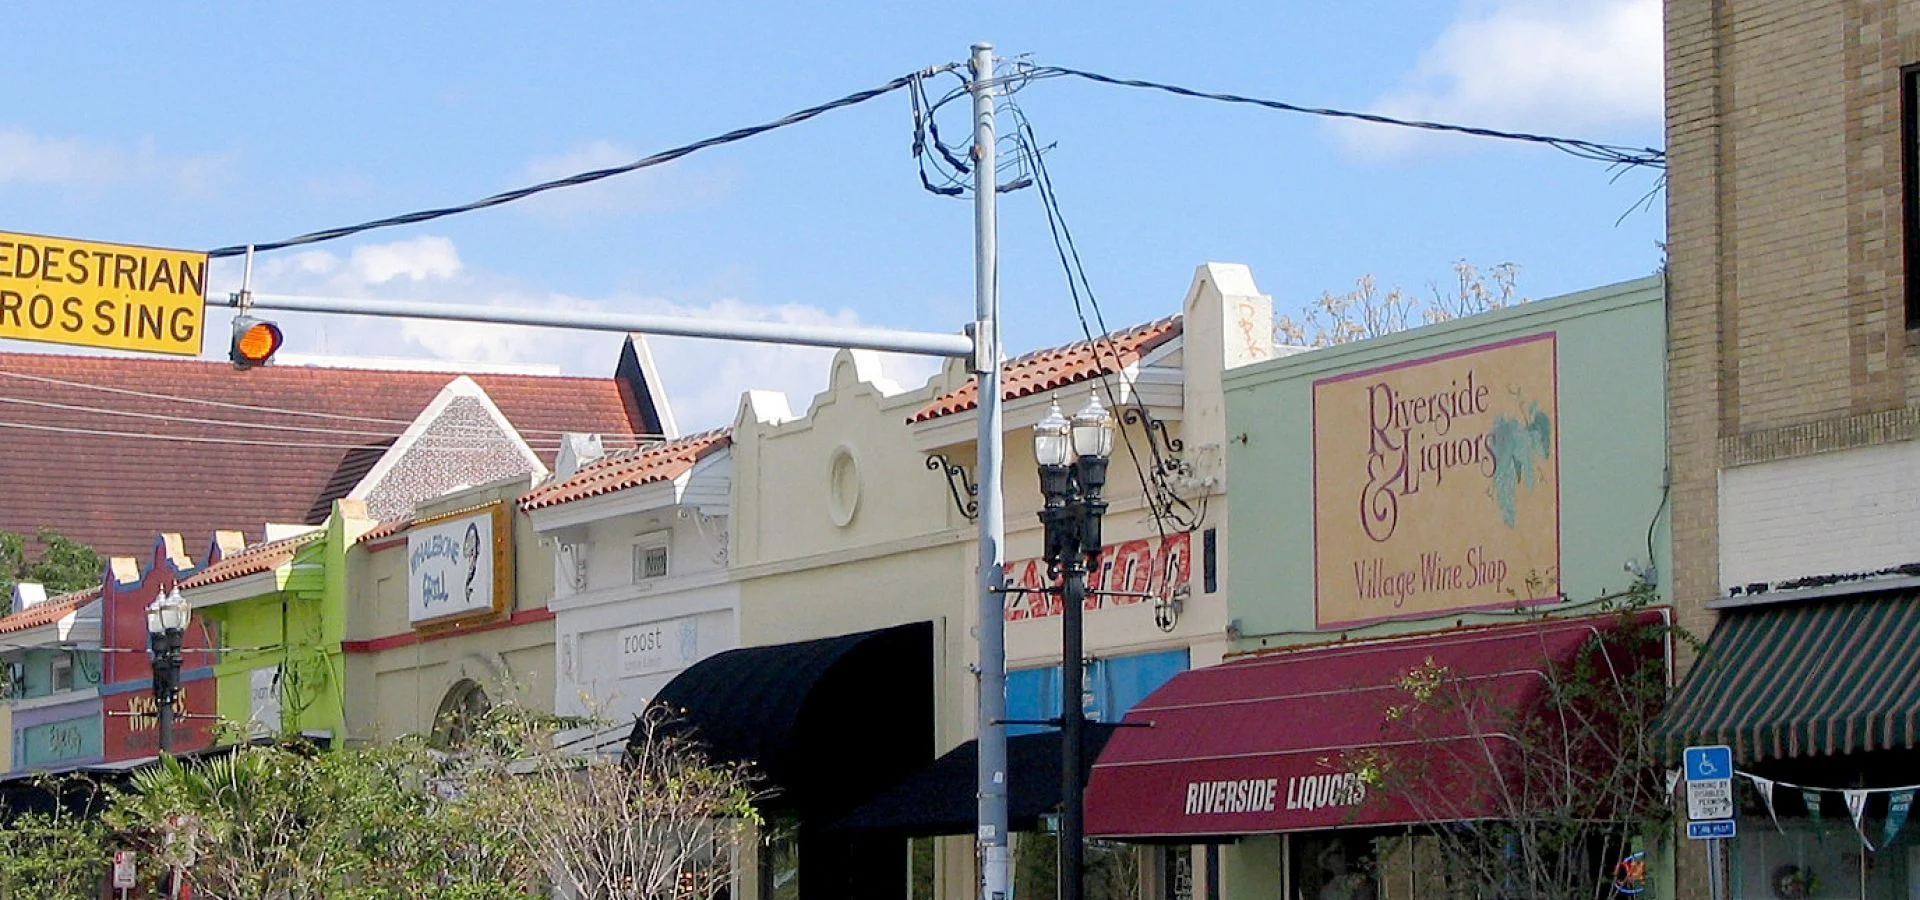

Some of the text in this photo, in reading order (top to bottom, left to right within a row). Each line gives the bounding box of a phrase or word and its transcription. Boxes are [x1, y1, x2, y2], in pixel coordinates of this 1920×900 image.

[0, 290, 194, 342] ROSSING
[1366, 370, 1489, 455] Riverside
[1361, 428, 1497, 542] & Liquors
[1354, 546, 1507, 608] Village Wine Shop
[624, 627, 662, 654] roost
[1185, 772, 1367, 815] RIVERSIDE LIQUORS
